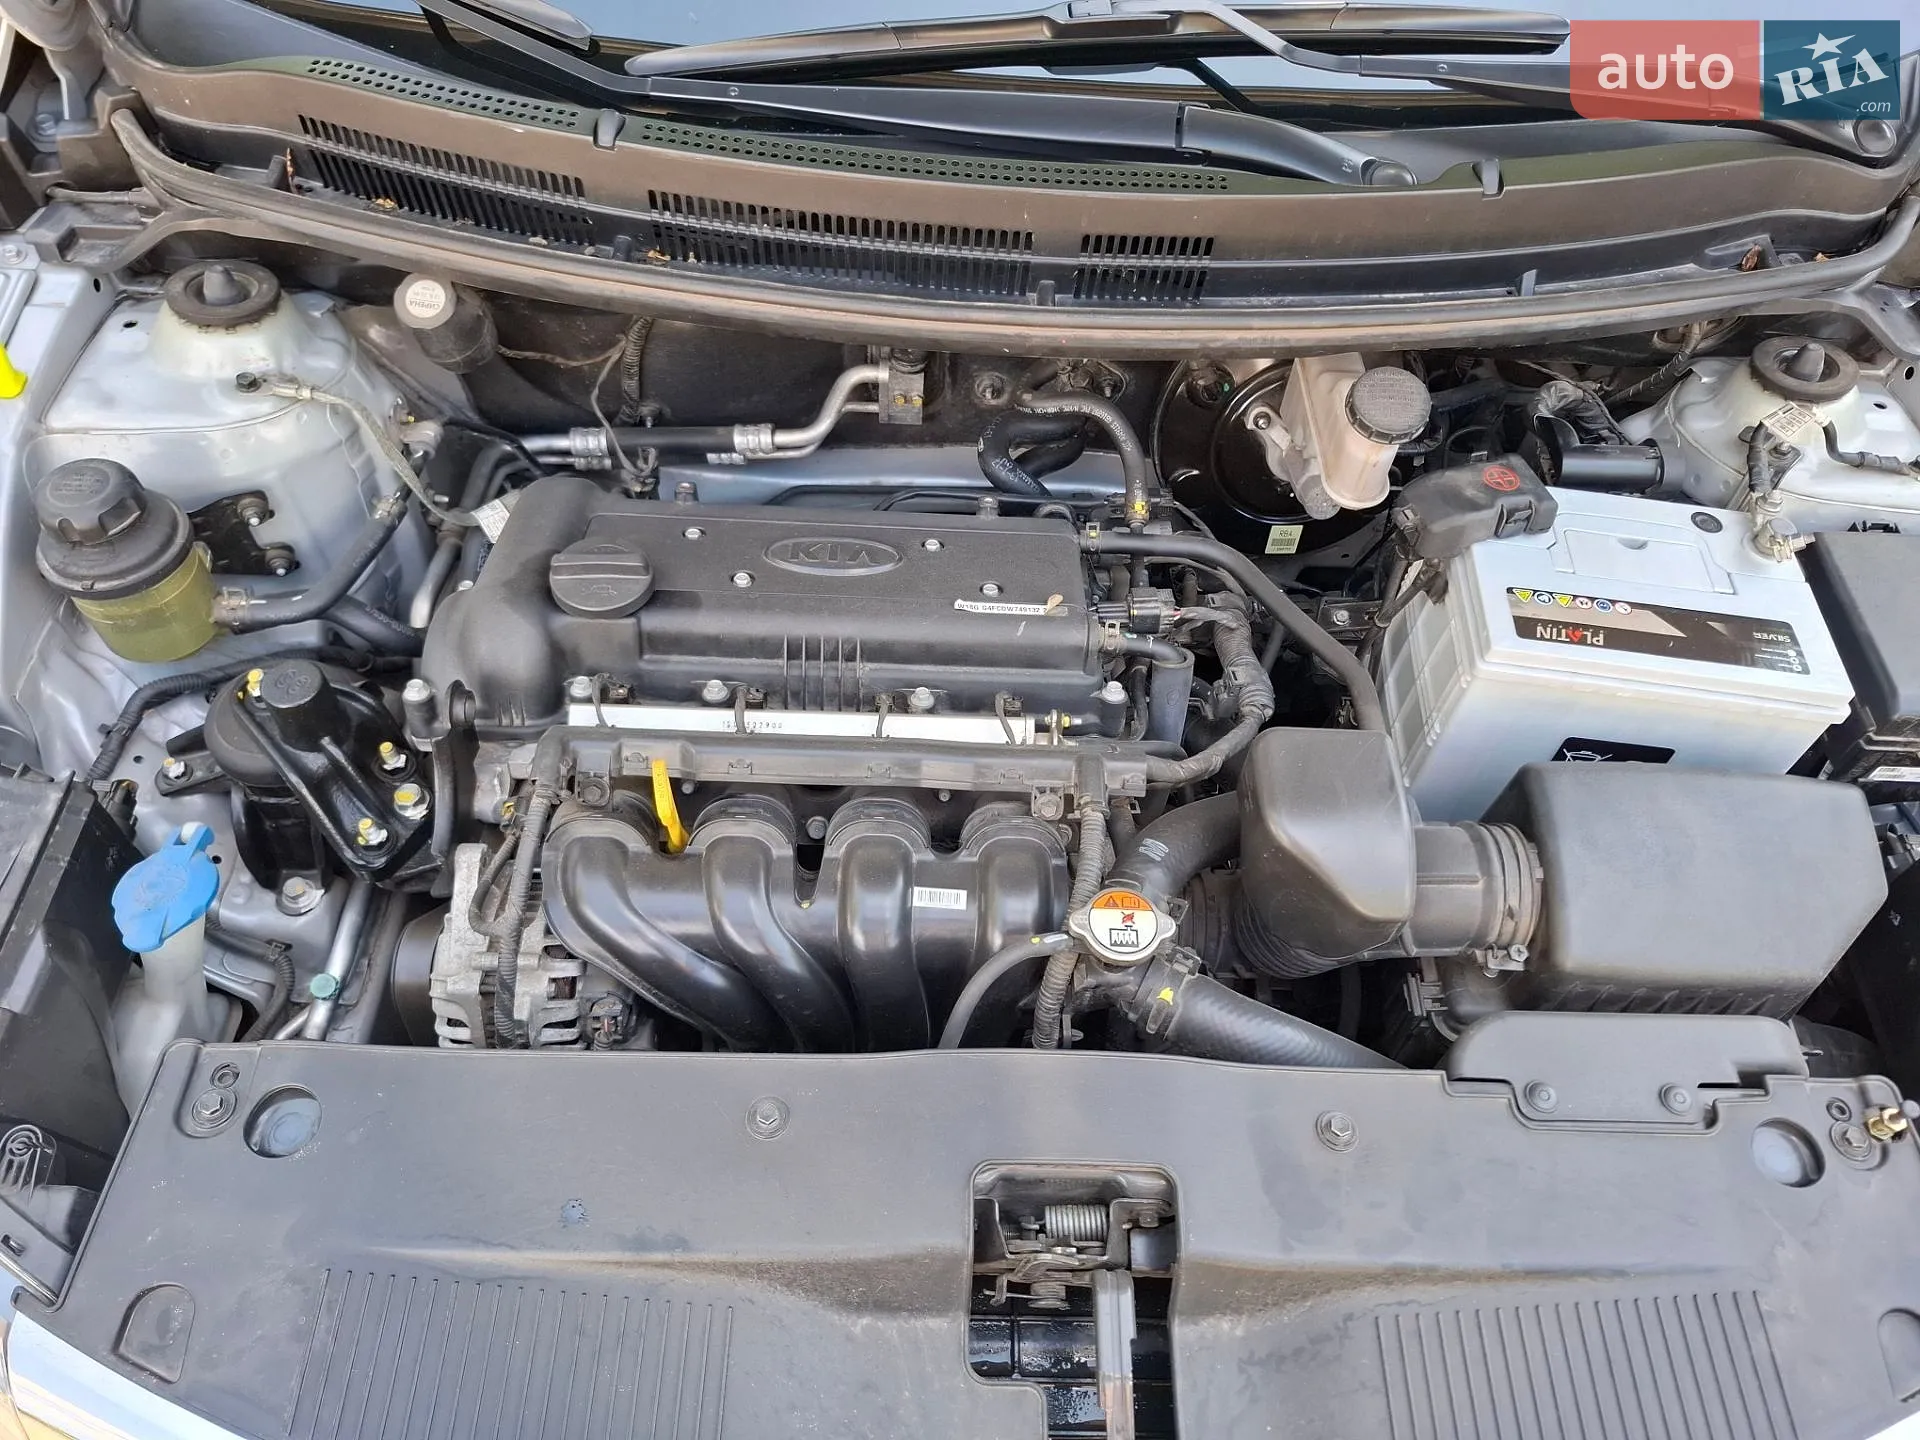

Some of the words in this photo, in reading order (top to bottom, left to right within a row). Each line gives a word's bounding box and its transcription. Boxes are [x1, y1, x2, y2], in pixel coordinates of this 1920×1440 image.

[788, 543, 881, 566] KIA
[1536, 625, 1605, 646] PLATIN
[1752, 631, 1791, 643] SILVER
